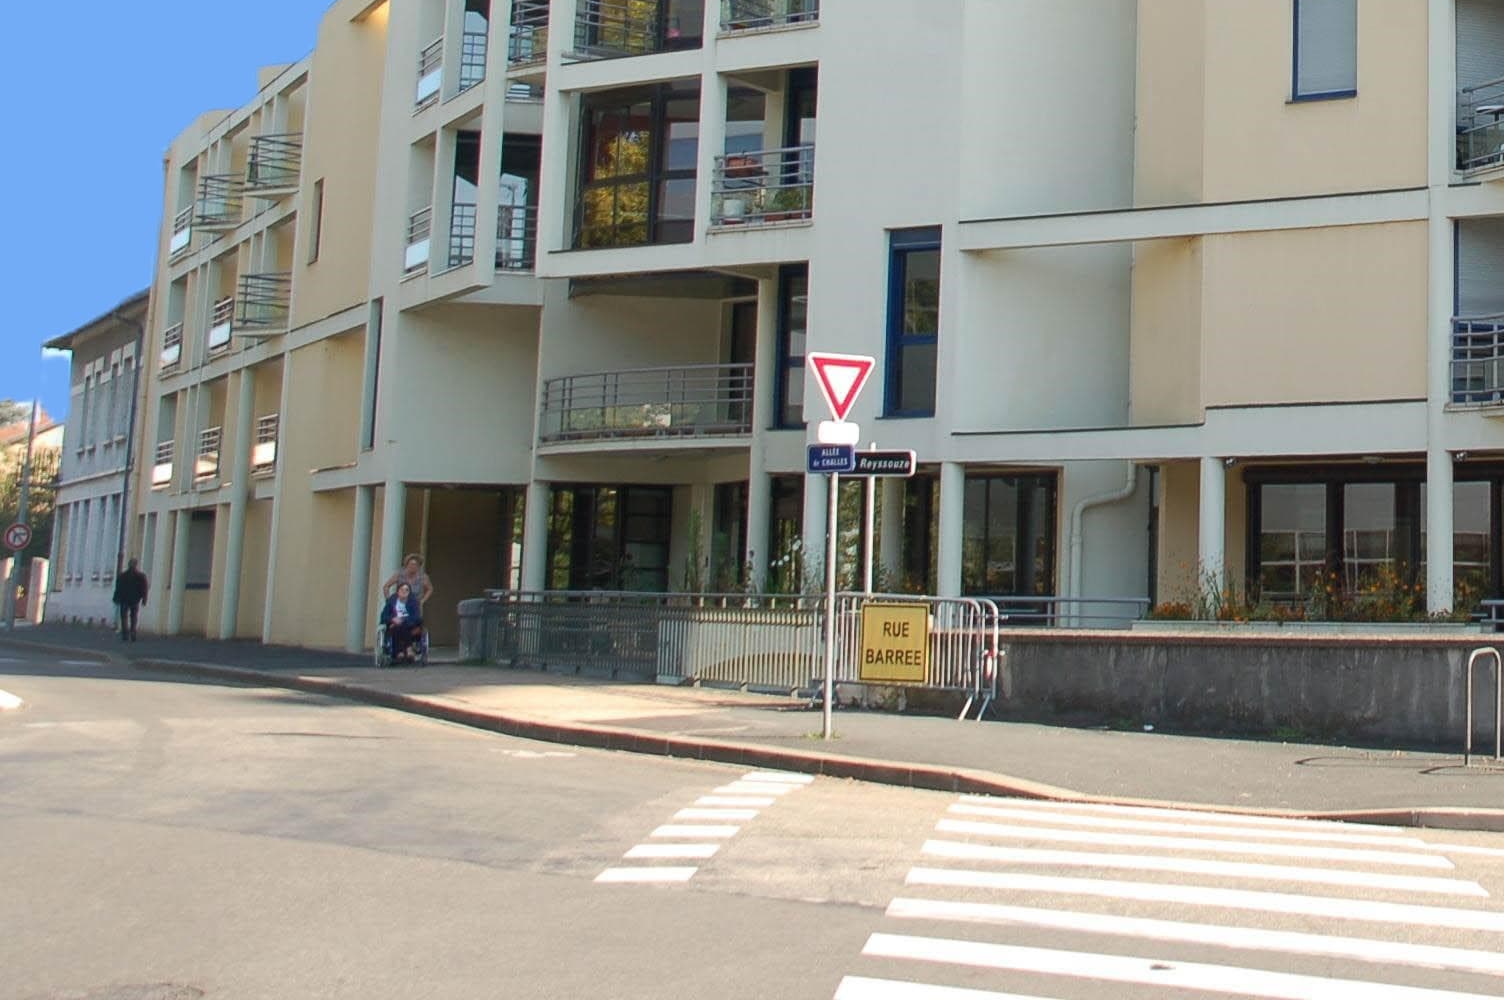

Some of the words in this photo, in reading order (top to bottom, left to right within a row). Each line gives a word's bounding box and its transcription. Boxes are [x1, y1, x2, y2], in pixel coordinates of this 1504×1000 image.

[822, 457, 848, 467] CHALLES
[860, 458, 910, 469] Reyssouze
[883, 621, 909, 637] RUE
[866, 648, 921, 666] BARREE
